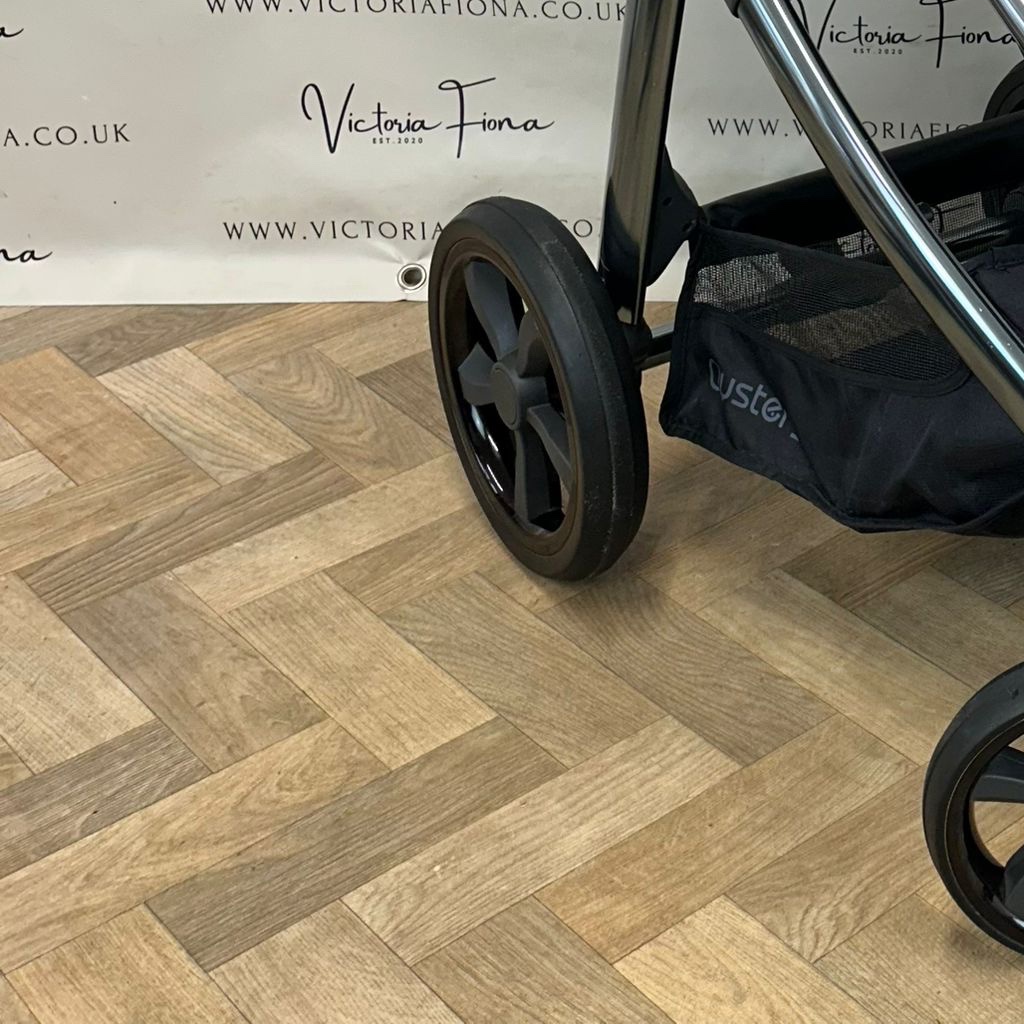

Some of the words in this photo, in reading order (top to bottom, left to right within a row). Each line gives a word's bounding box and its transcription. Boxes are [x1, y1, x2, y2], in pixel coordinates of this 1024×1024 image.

[301, 83, 441, 154] Victoria
[438, 77, 555, 159] Fiona
[3, 123, 130, 148] A.CO.UK
[372, 136, 424, 145] EST.2020
